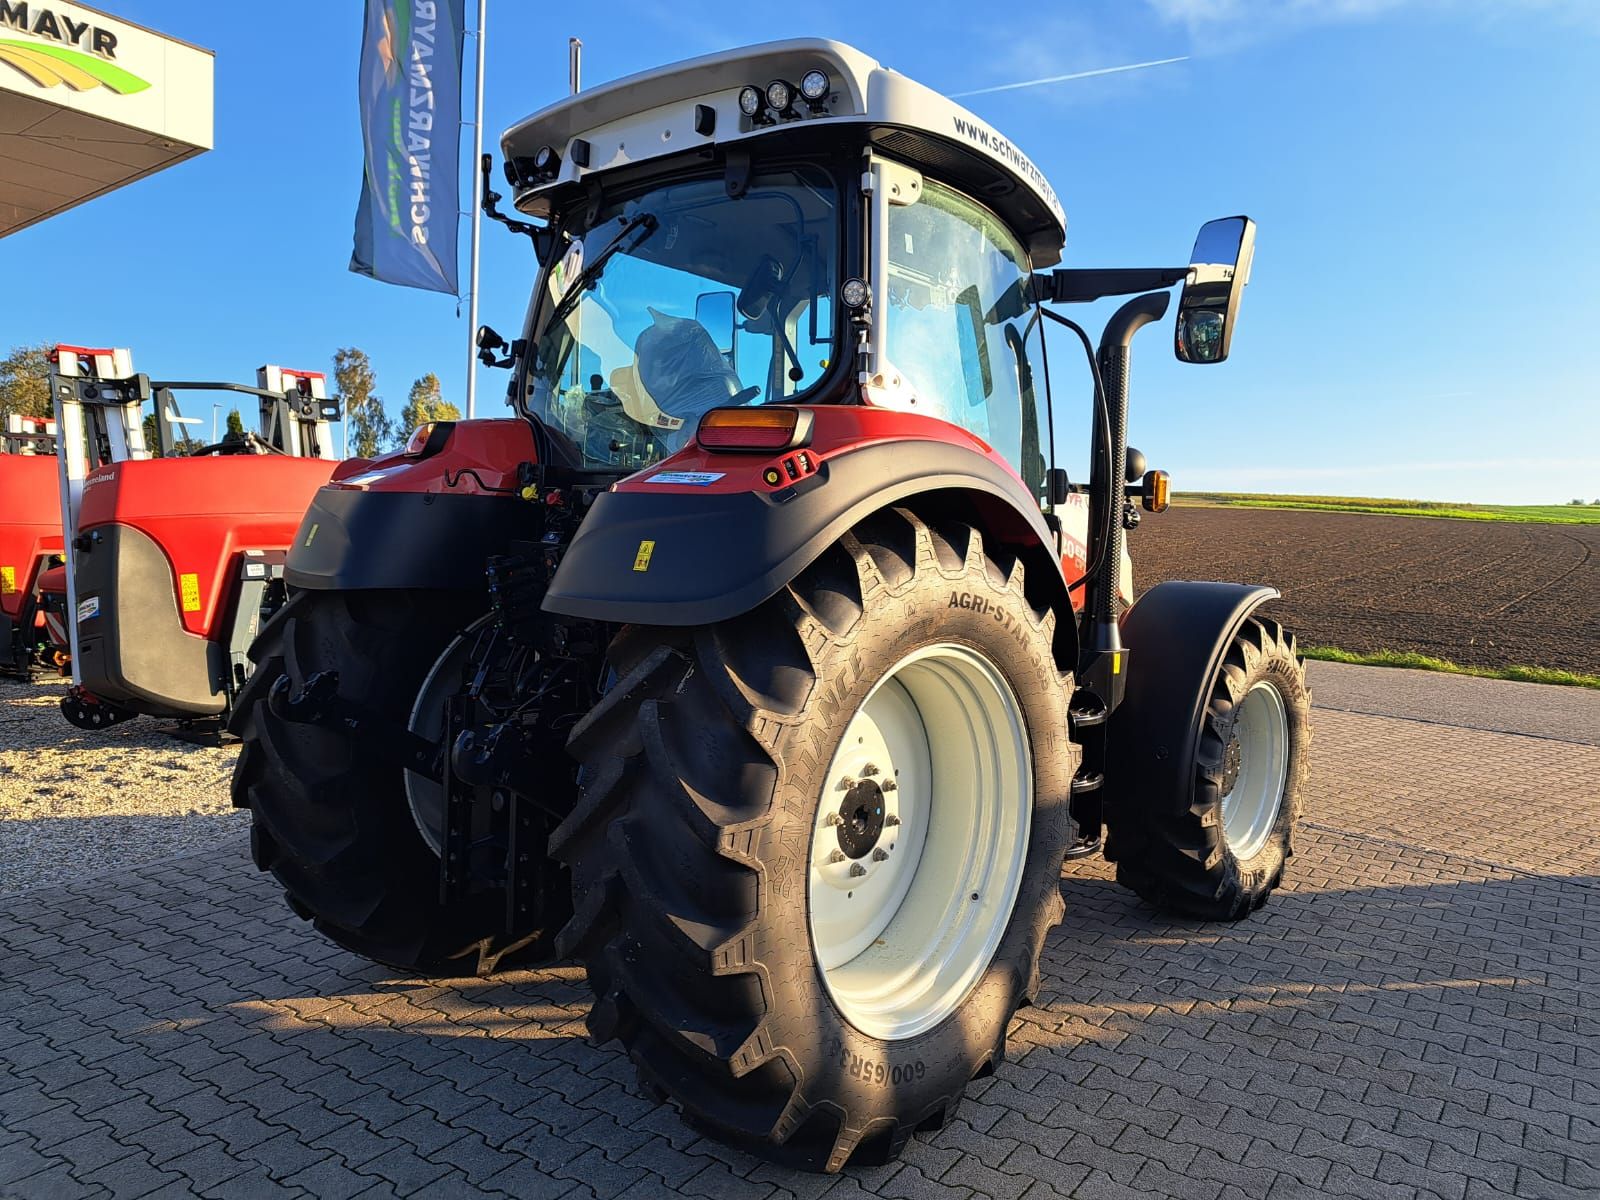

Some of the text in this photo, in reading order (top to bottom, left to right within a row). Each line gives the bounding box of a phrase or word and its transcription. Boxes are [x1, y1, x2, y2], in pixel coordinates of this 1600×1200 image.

[0, 0, 118, 59] MAYR
[948, 591, 1030, 651] AGRI-STAR
[780, 643, 865, 859] ALLIANCE
